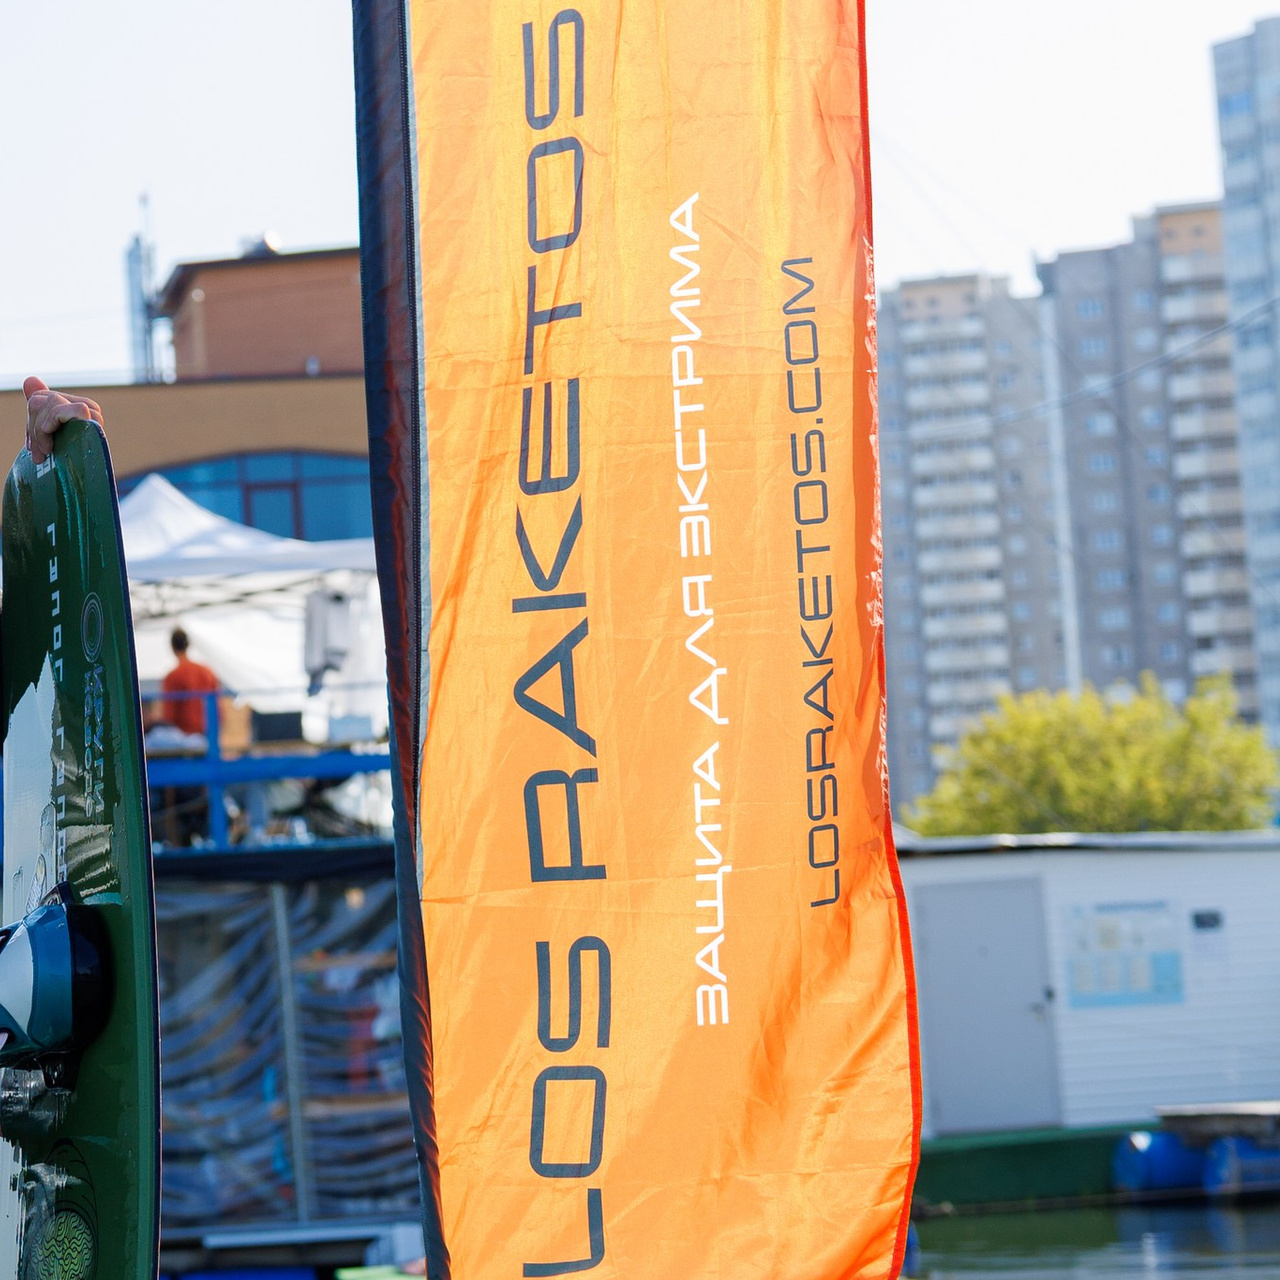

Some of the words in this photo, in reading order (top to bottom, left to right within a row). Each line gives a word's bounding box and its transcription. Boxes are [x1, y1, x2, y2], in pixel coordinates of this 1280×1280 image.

[512, 8, 607, 883] RAKETOS
[669, 192, 712, 556] ЭКСТРИМА
[93, 664, 105, 813] КРУГИ
[681, 574, 729, 724] ДЛЯ
[781, 256, 841, 907] LOSRAKETOS.COM
[692, 742, 732, 1025] ЗАЩИТА
[523, 935, 612, 1278] LOS
